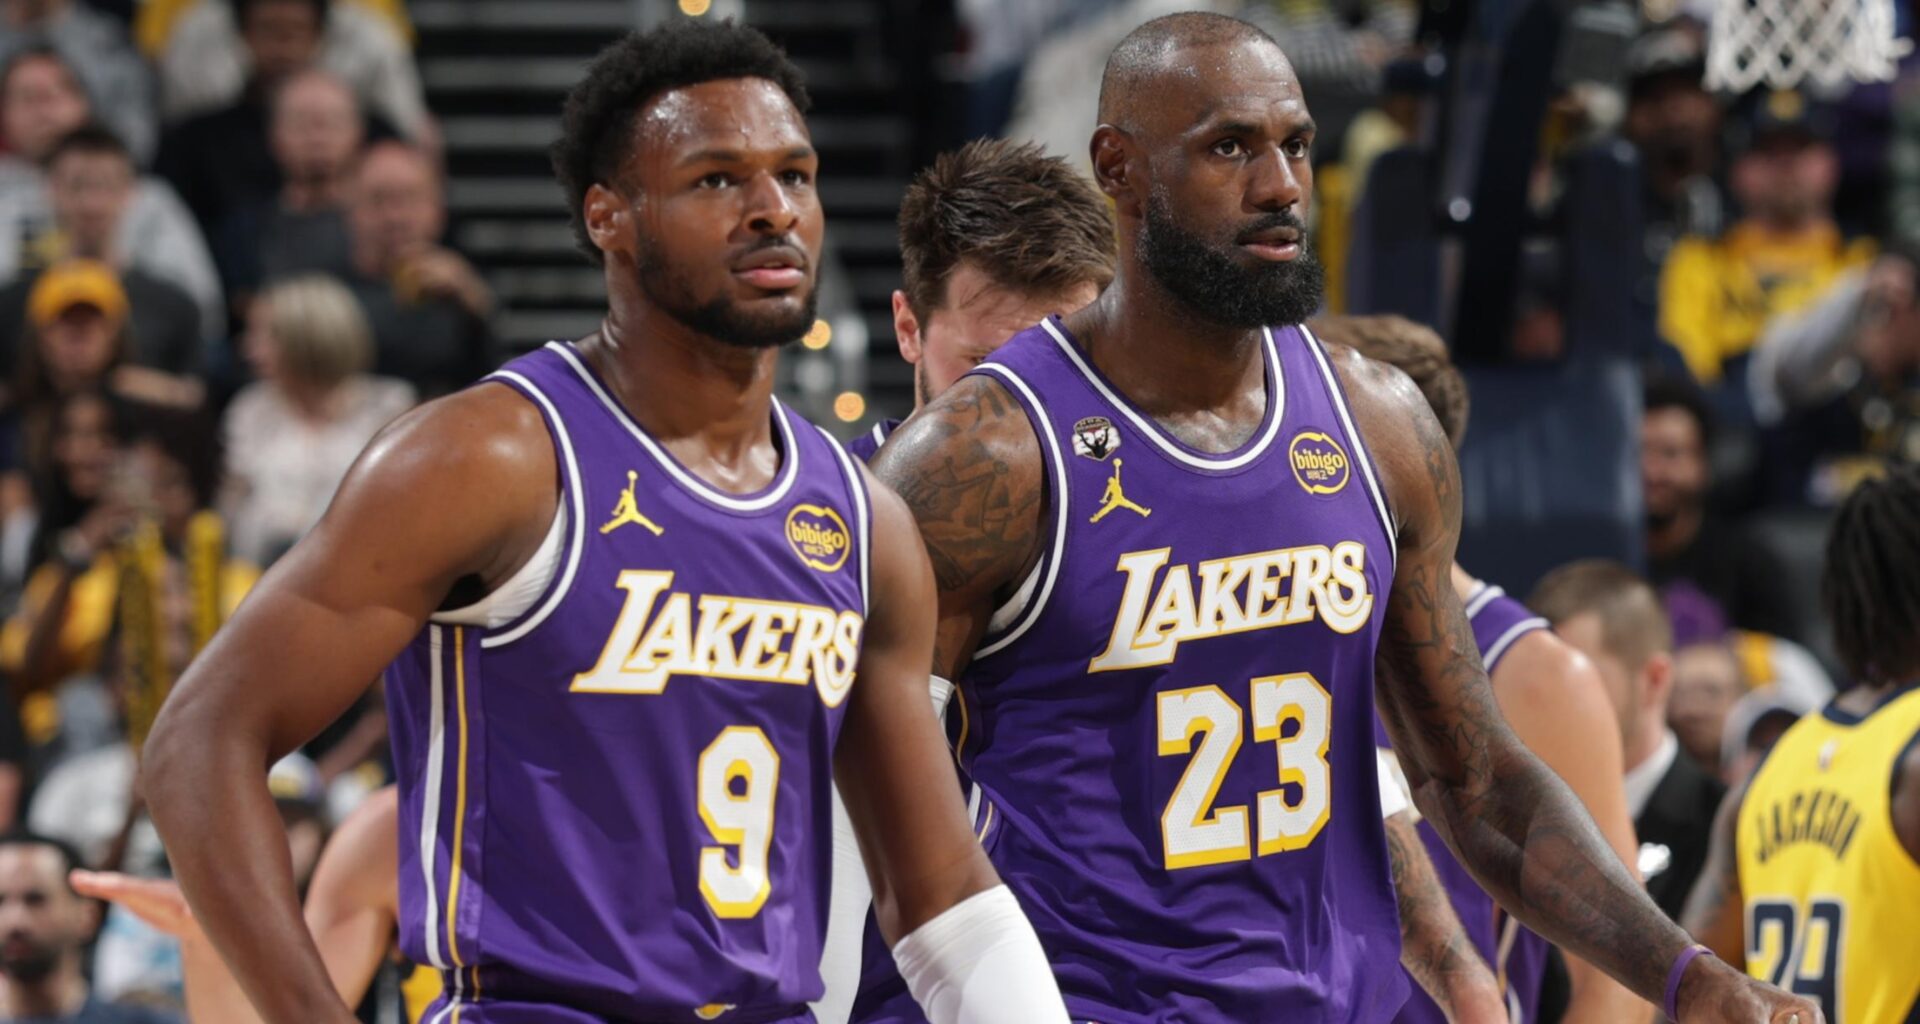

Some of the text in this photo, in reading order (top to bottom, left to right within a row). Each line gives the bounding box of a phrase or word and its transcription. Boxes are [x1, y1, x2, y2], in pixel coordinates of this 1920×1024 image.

[1294, 448, 1344, 476] bibigo
[791, 521, 845, 554] bibigo
[569, 569, 864, 708] LAKERS
[1087, 540, 1373, 674] LAKERS
[697, 725, 780, 919] 9
[1156, 671, 1333, 870] 23
[1757, 788, 1862, 864] JACKSON
